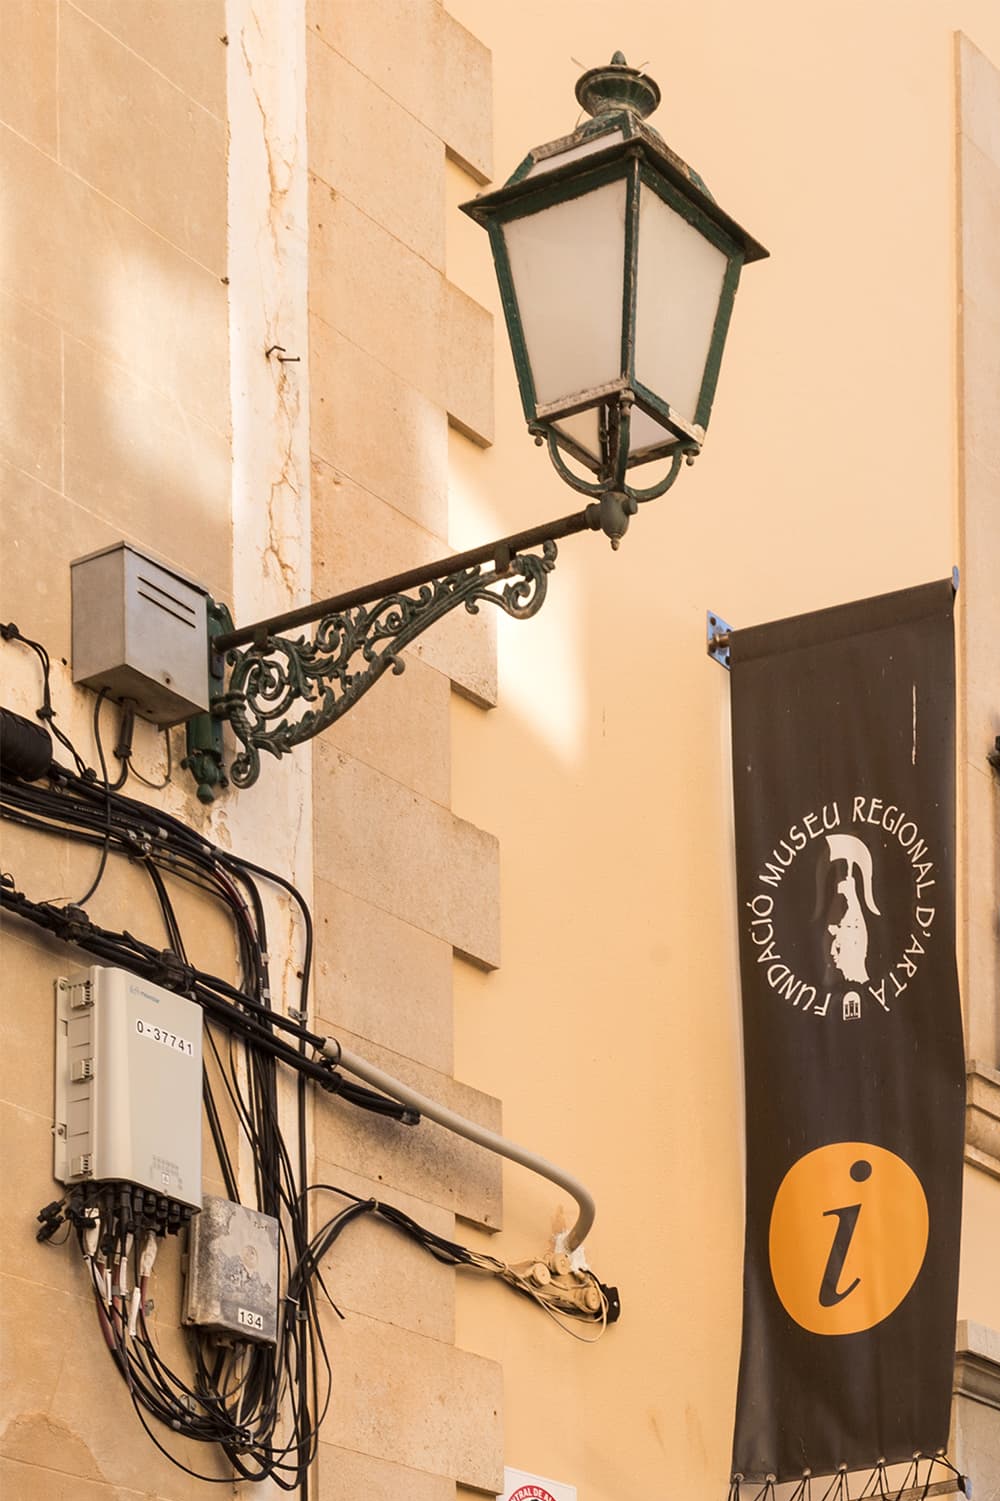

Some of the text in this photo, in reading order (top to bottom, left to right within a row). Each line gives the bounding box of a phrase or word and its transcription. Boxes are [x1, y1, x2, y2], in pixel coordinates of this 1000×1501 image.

[758, 801, 840, 888] MUSEU
[852, 796, 936, 899] REGIONAL
[747, 895, 832, 1017] FUNDACIÓ
[136, 1020, 193, 1056] 0-37741
[818, 1159, 872, 1308] i
[239, 1310, 262, 1330] 134
[533, 1487, 544, 1500] DE
